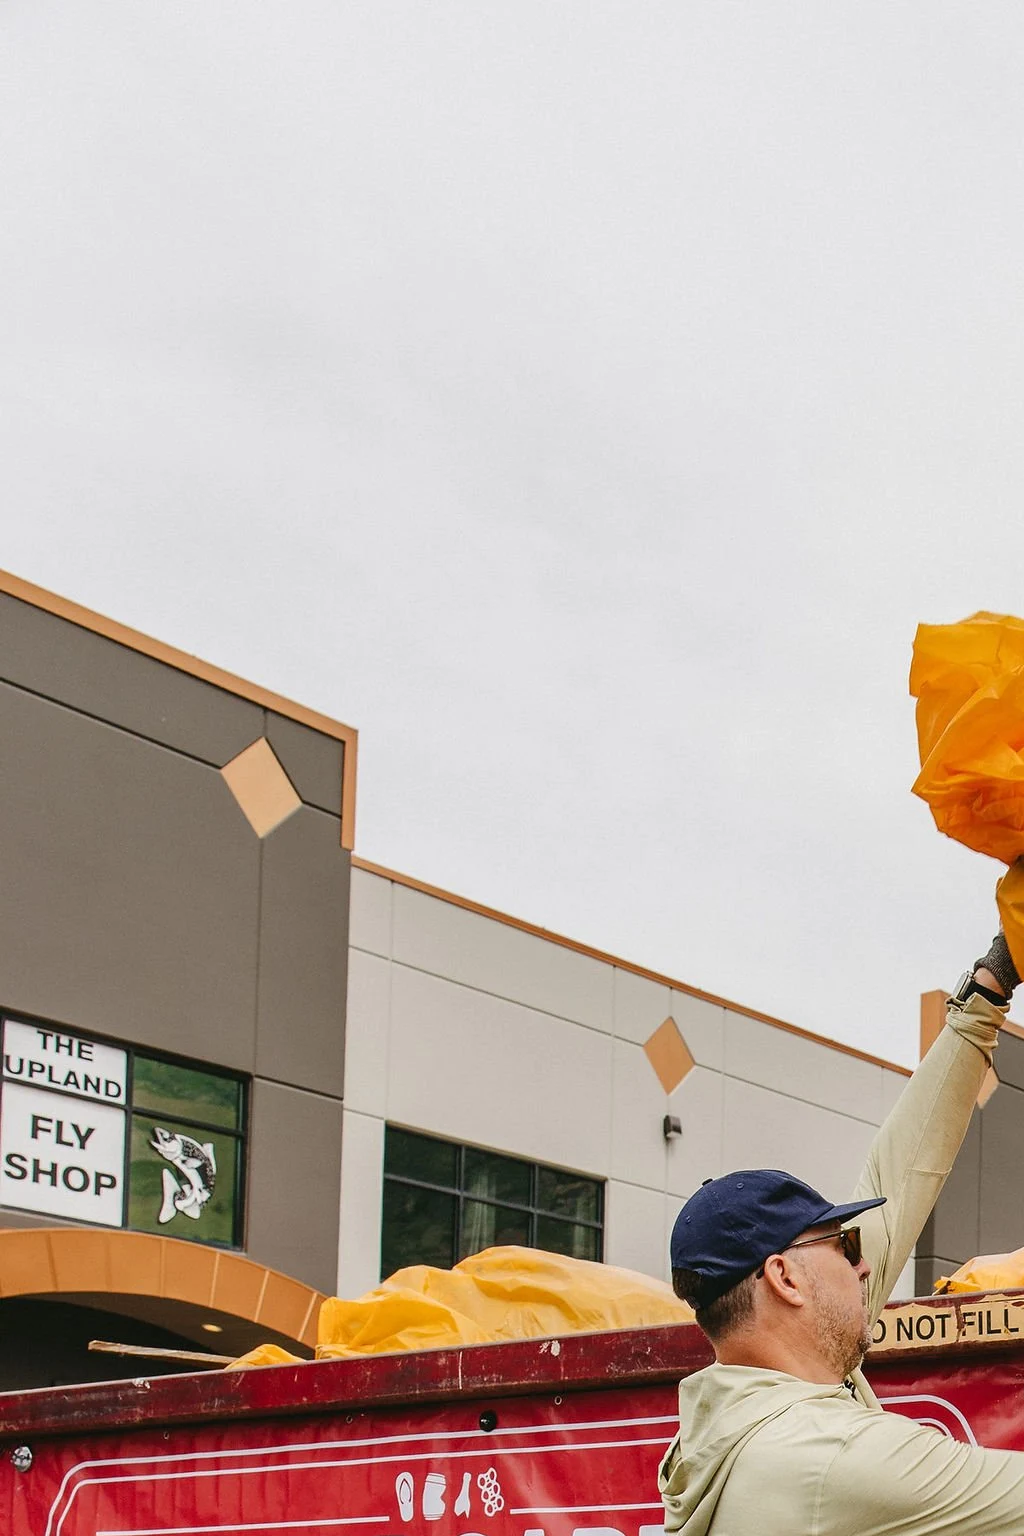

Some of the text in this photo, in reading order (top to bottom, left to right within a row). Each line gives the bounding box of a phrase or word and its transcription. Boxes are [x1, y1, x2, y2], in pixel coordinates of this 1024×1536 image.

[37, 1030, 94, 1062] THE
[4, 1054, 122, 1098] UPLAND
[30, 1114, 96, 1150] FLY
[4, 1152, 117, 1197] SHOP
[872, 1319, 887, 1343] O
[896, 1313, 951, 1342] NOT
[962, 1308, 1019, 1337] FILL
